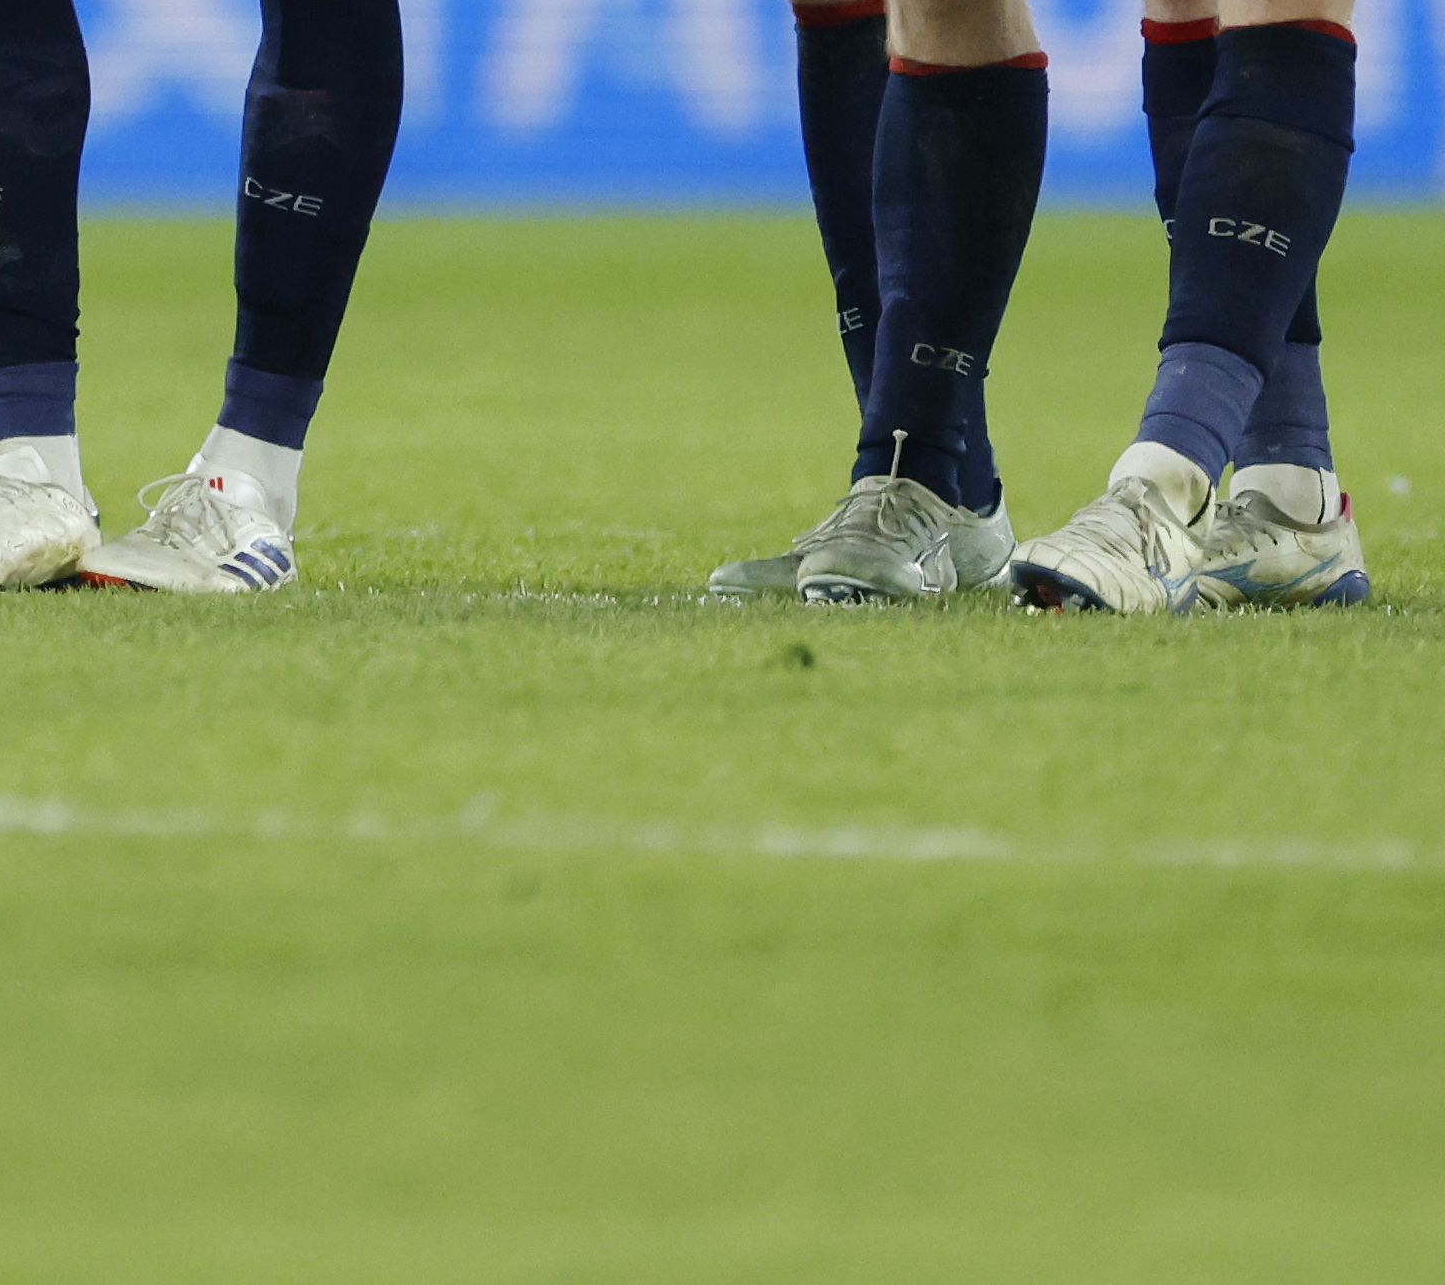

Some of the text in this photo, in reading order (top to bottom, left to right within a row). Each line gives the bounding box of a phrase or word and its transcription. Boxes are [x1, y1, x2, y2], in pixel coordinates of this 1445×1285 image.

[245, 176, 323, 216] CZE
[1208, 217, 1291, 256] CZE
[911, 342, 974, 375] CZE
